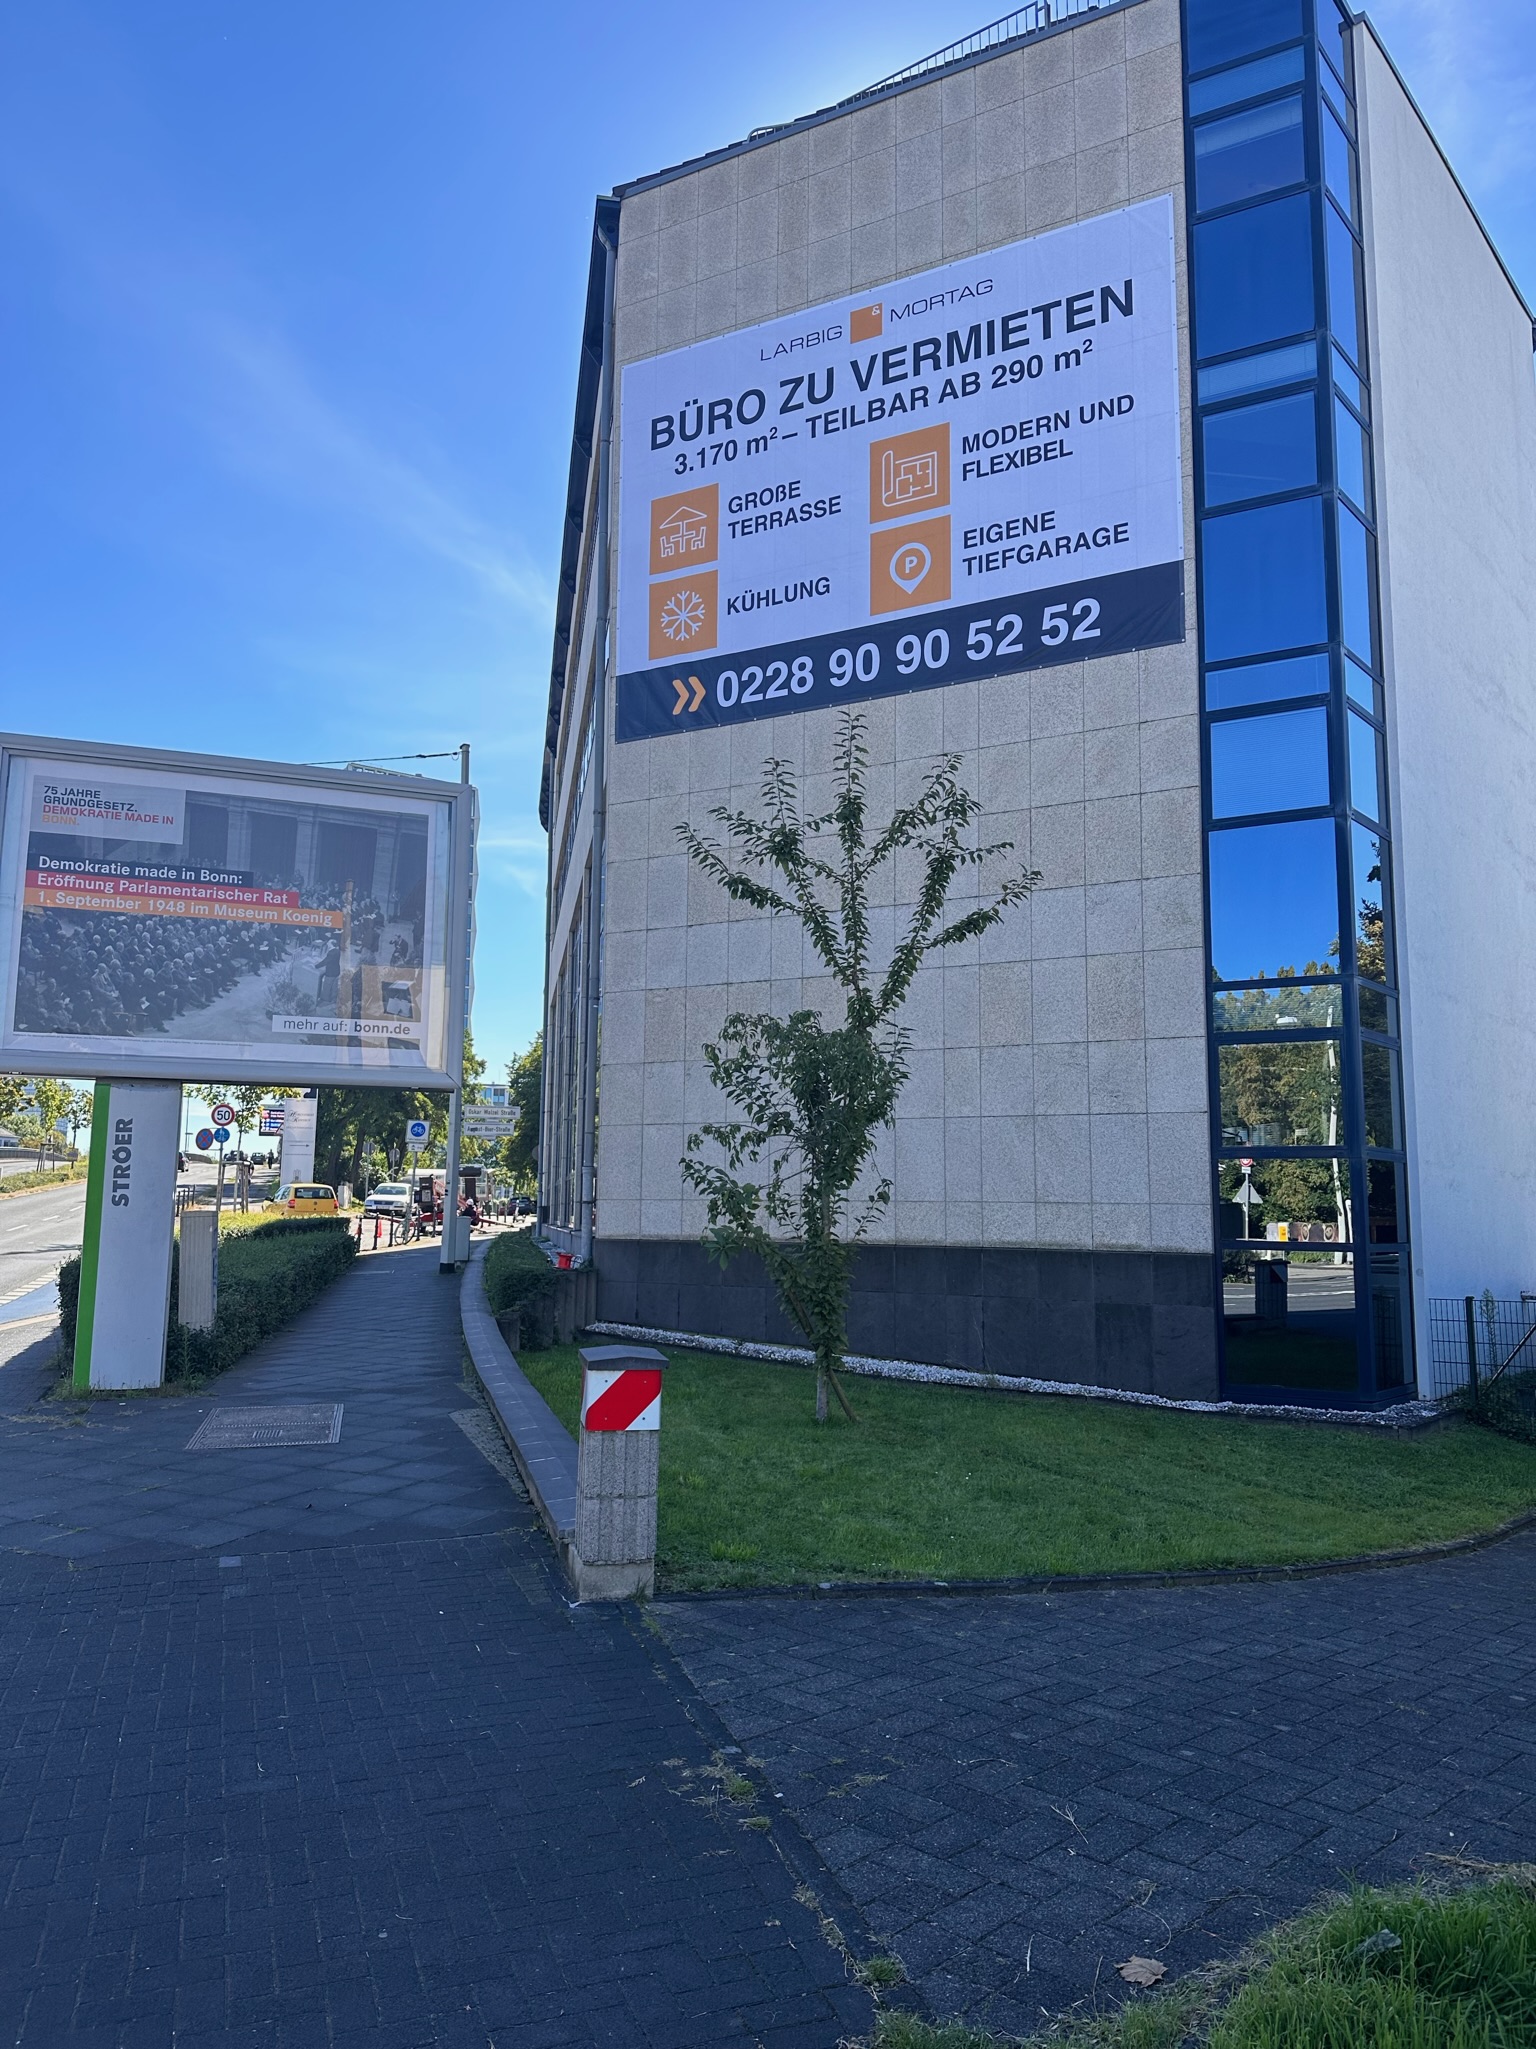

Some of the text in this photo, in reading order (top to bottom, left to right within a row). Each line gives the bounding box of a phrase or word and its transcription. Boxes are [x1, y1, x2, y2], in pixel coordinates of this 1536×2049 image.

[760, 325, 842, 361] LARBIG
[890, 279, 993, 322] MORTAG
[651, 278, 1134, 451] BÜRO ZU VERMIETEN
[674, 439, 738, 475] 3.170
[805, 385, 929, 439] TEILBAR
[938, 371, 981, 404] AB
[991, 354, 1044, 389] 290
[962, 394, 1135, 455] MODERN UND
[962, 438, 1073, 482] FLEXIBEL
[728, 480, 801, 514] GROßE
[727, 495, 842, 539] TERRASSE
[963, 510, 1056, 549] EIGENE
[905, 556, 918, 573] P
[962, 522, 1130, 576] TIEFGARAGE
[727, 576, 830, 615] KÜHLUNG
[716, 598, 1101, 707] 0228 90 90 52 52
[43, 795, 138, 812] GRUNDGESETZ.
[44, 785, 101, 799] 75 JAHRE
[42, 814, 80, 826] BONN.
[43, 804, 174, 825] DEMOKRATIE MADE IN
[38, 856, 243, 885] Demokratie made in Bonn:
[37, 873, 288, 905] Eröffnung Parlamentarischer Rat
[38, 890, 333, 926] 1. September 1948 im Museum Koenig
[283, 1019, 411, 1035] mehr auf: bonn.de
[216, 1110, 231, 1121] 50
[484, 1108, 499, 1116] Walzel
[111, 1117, 134, 1208] STRÖER
